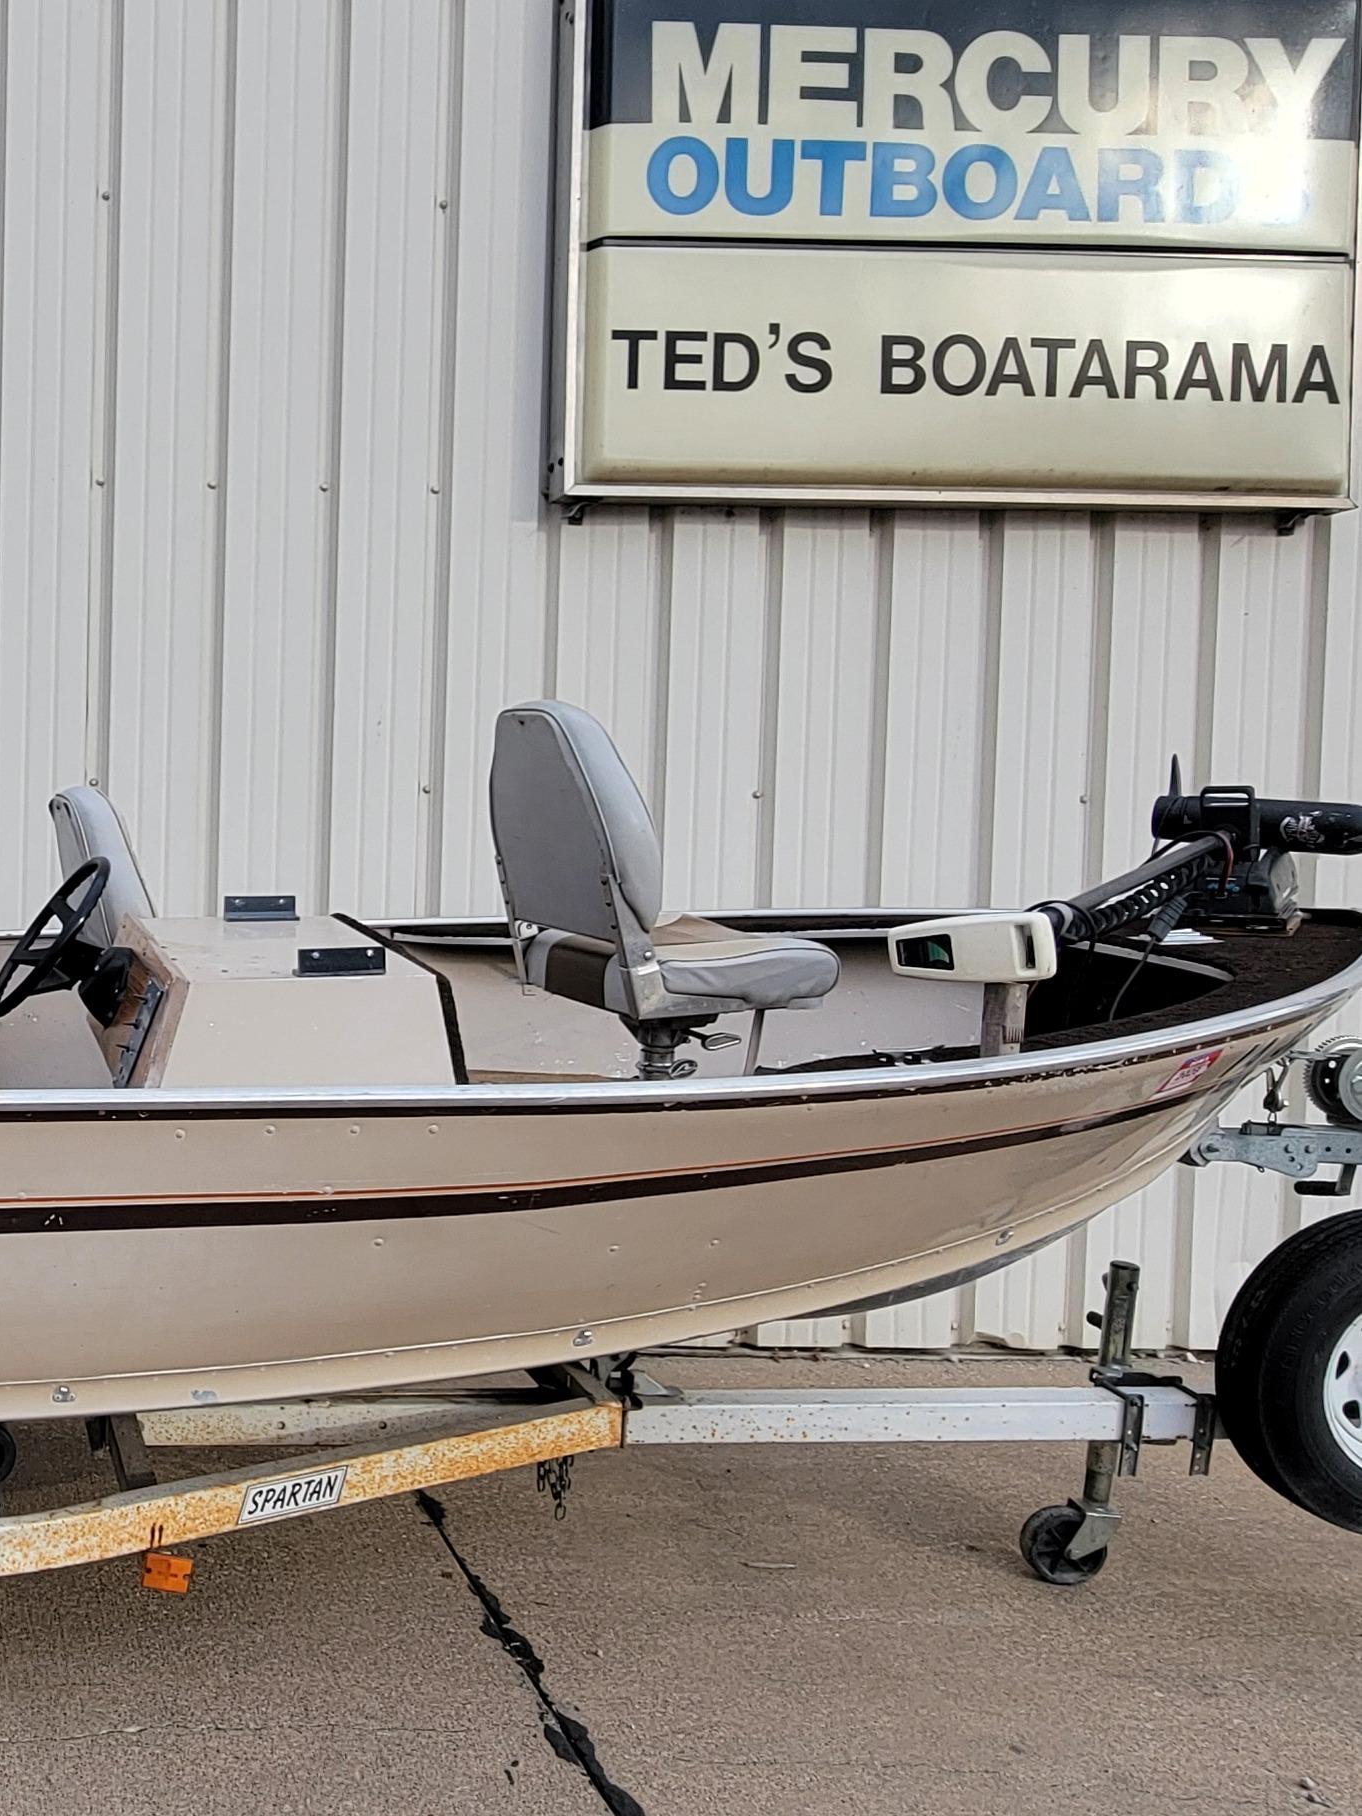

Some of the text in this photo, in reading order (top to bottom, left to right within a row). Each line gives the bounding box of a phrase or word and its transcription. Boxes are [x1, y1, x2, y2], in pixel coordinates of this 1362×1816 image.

[650, 20, 1347, 138] MERCURY
[646, 136, 1310, 225] OUTBOARD
[611, 323, 1341, 405] TED'S BOATARAMA
[247, 1474, 338, 1515] SPARTAN
